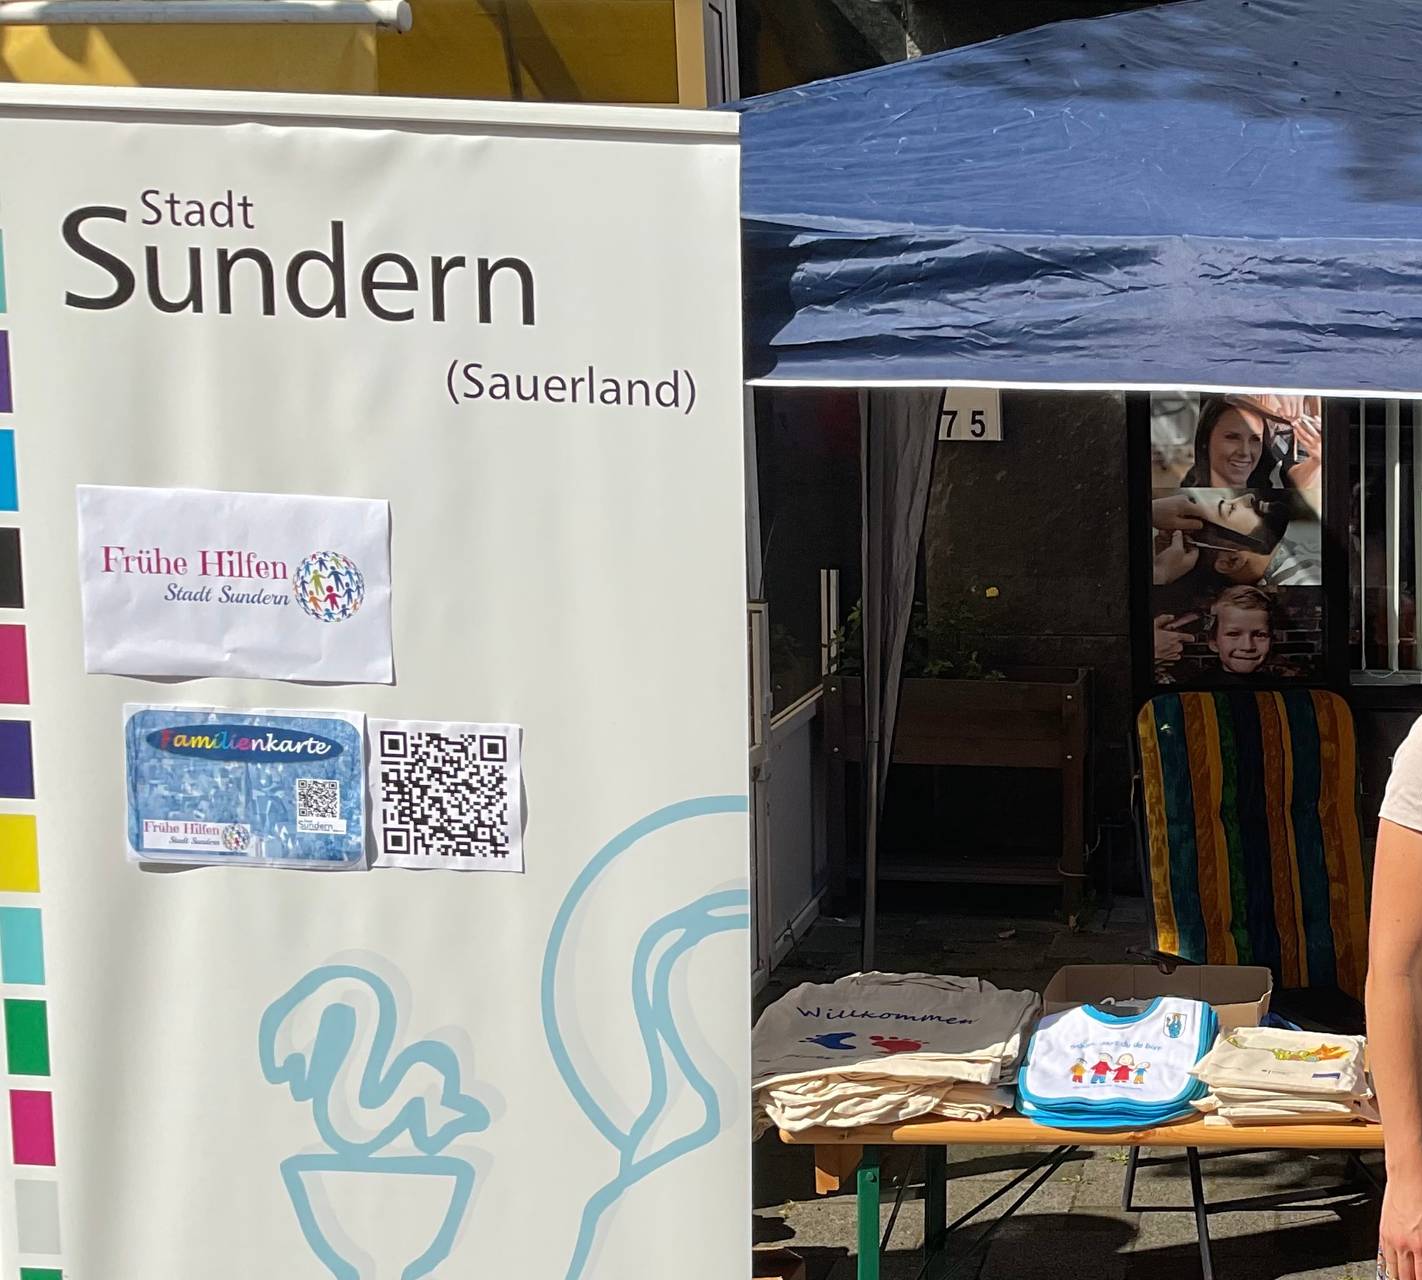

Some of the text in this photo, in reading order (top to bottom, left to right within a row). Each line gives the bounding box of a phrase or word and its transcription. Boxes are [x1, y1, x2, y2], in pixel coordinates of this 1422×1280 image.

[140, 189, 256, 230] Stadt
[61, 205, 536, 326] Sundern
[445, 359, 698, 415] (Sauerland)
[101, 545, 288, 580] Frühe Hilfen
[163, 582, 290, 606] Stadt Sundern
[160, 729, 331, 755] Familienkarte
[144, 821, 220, 836] Frühe Hilfen
[796, 1006, 980, 1025] Willkommen
